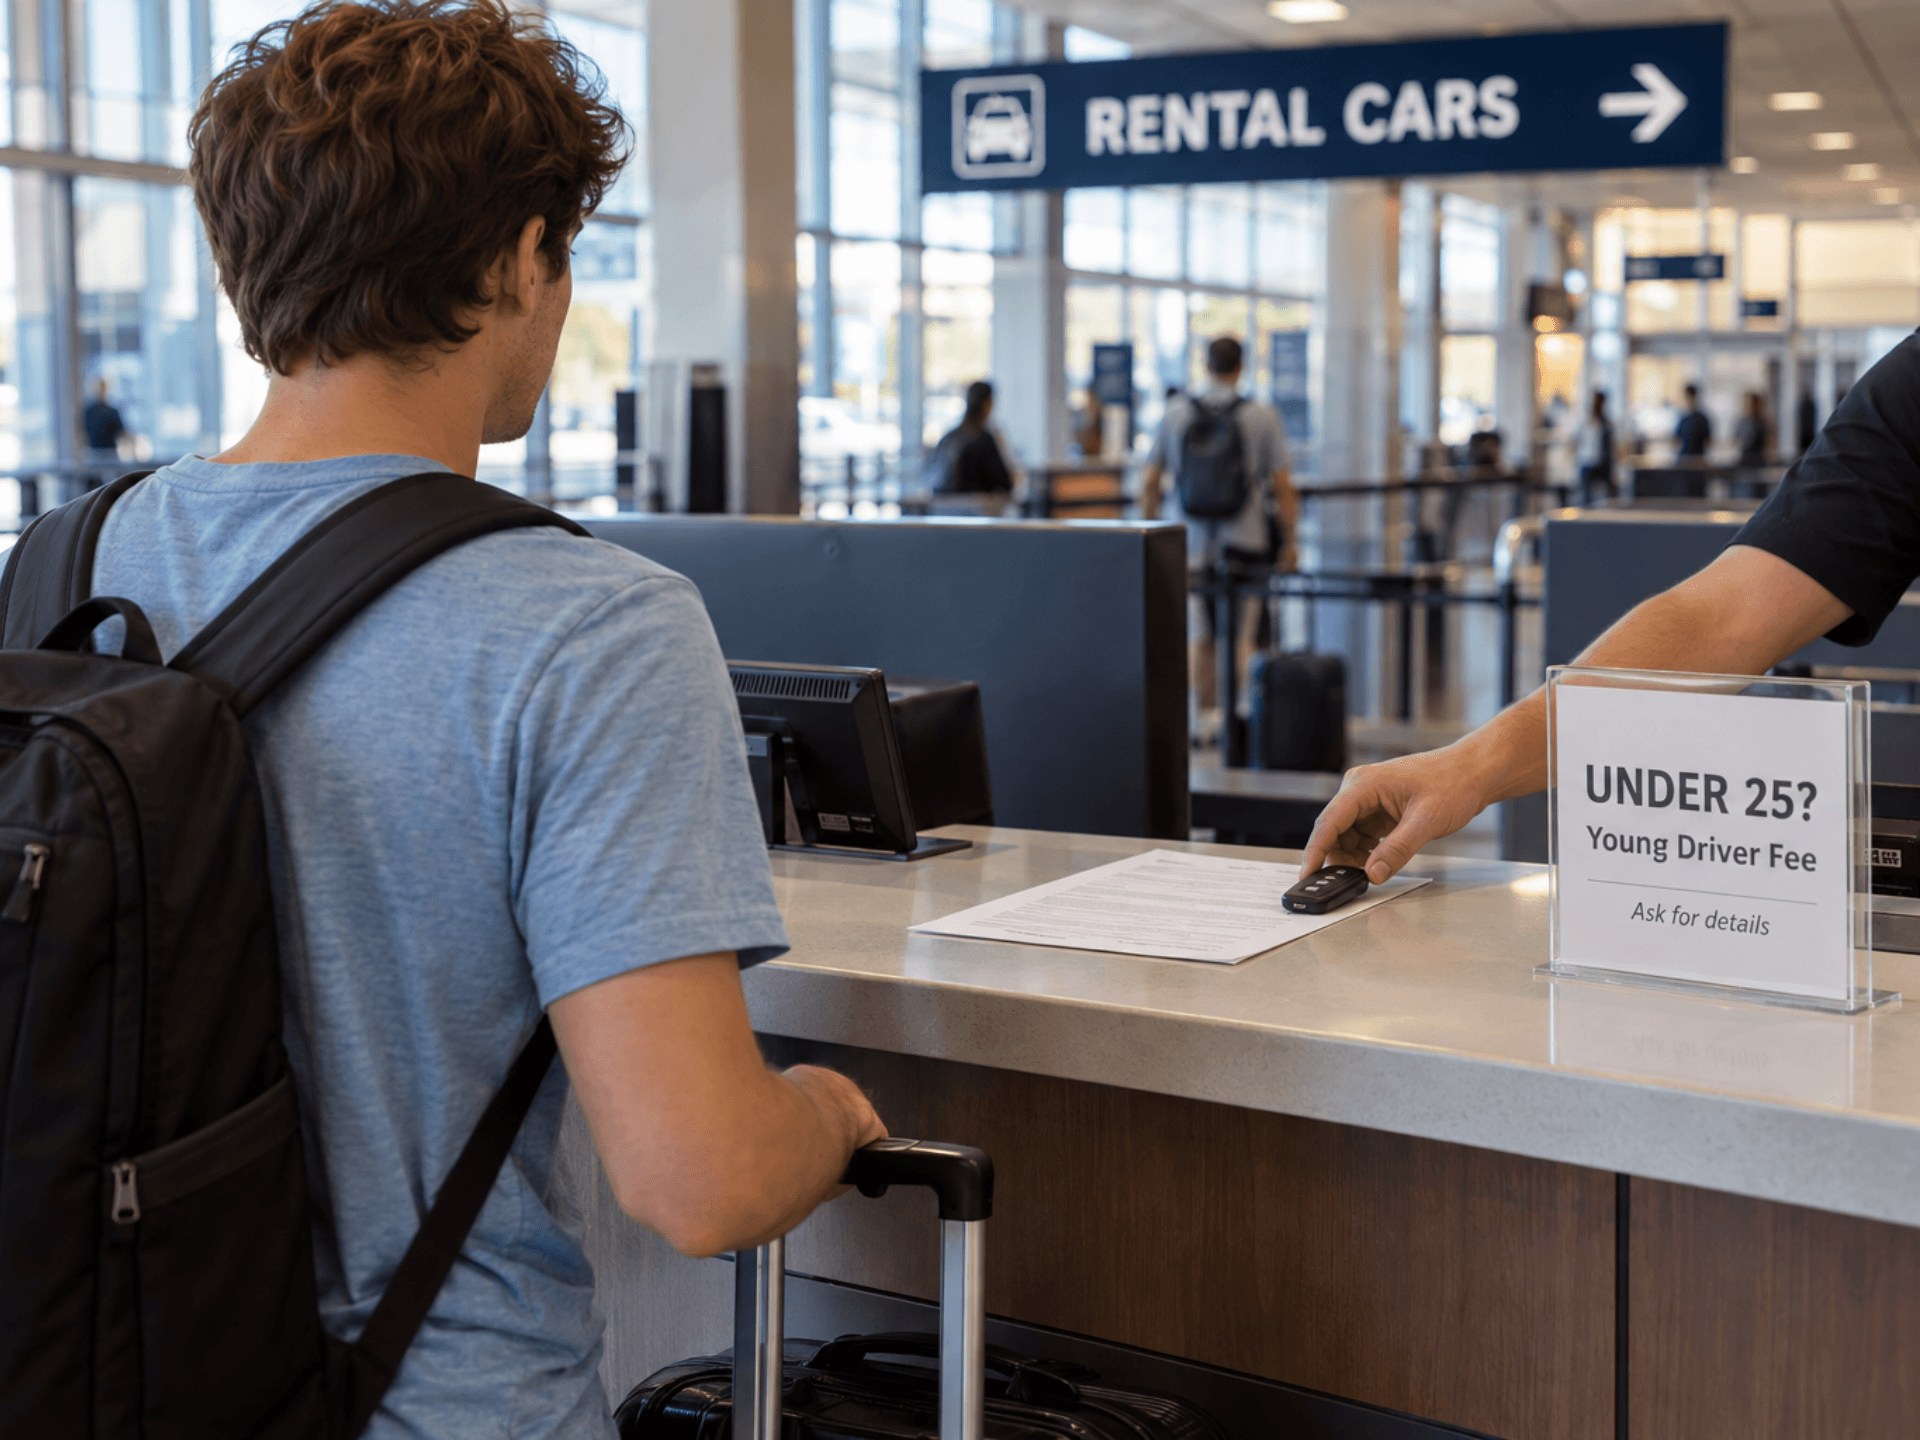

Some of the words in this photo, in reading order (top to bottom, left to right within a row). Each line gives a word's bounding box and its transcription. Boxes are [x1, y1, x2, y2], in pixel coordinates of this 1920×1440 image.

[1085, 87, 1326, 156] RENTAL
[1343, 75, 1520, 145] CARS
[1586, 763, 1730, 815] UNDER
[1744, 776, 1819, 823] 25?
[1586, 824, 1669, 864] Young
[1677, 833, 1762, 868] Driver
[1769, 842, 1818, 874] Fee
[1630, 901, 1667, 924] Ask
[1671, 904, 1701, 928] for
[1704, 909, 1771, 936] details
